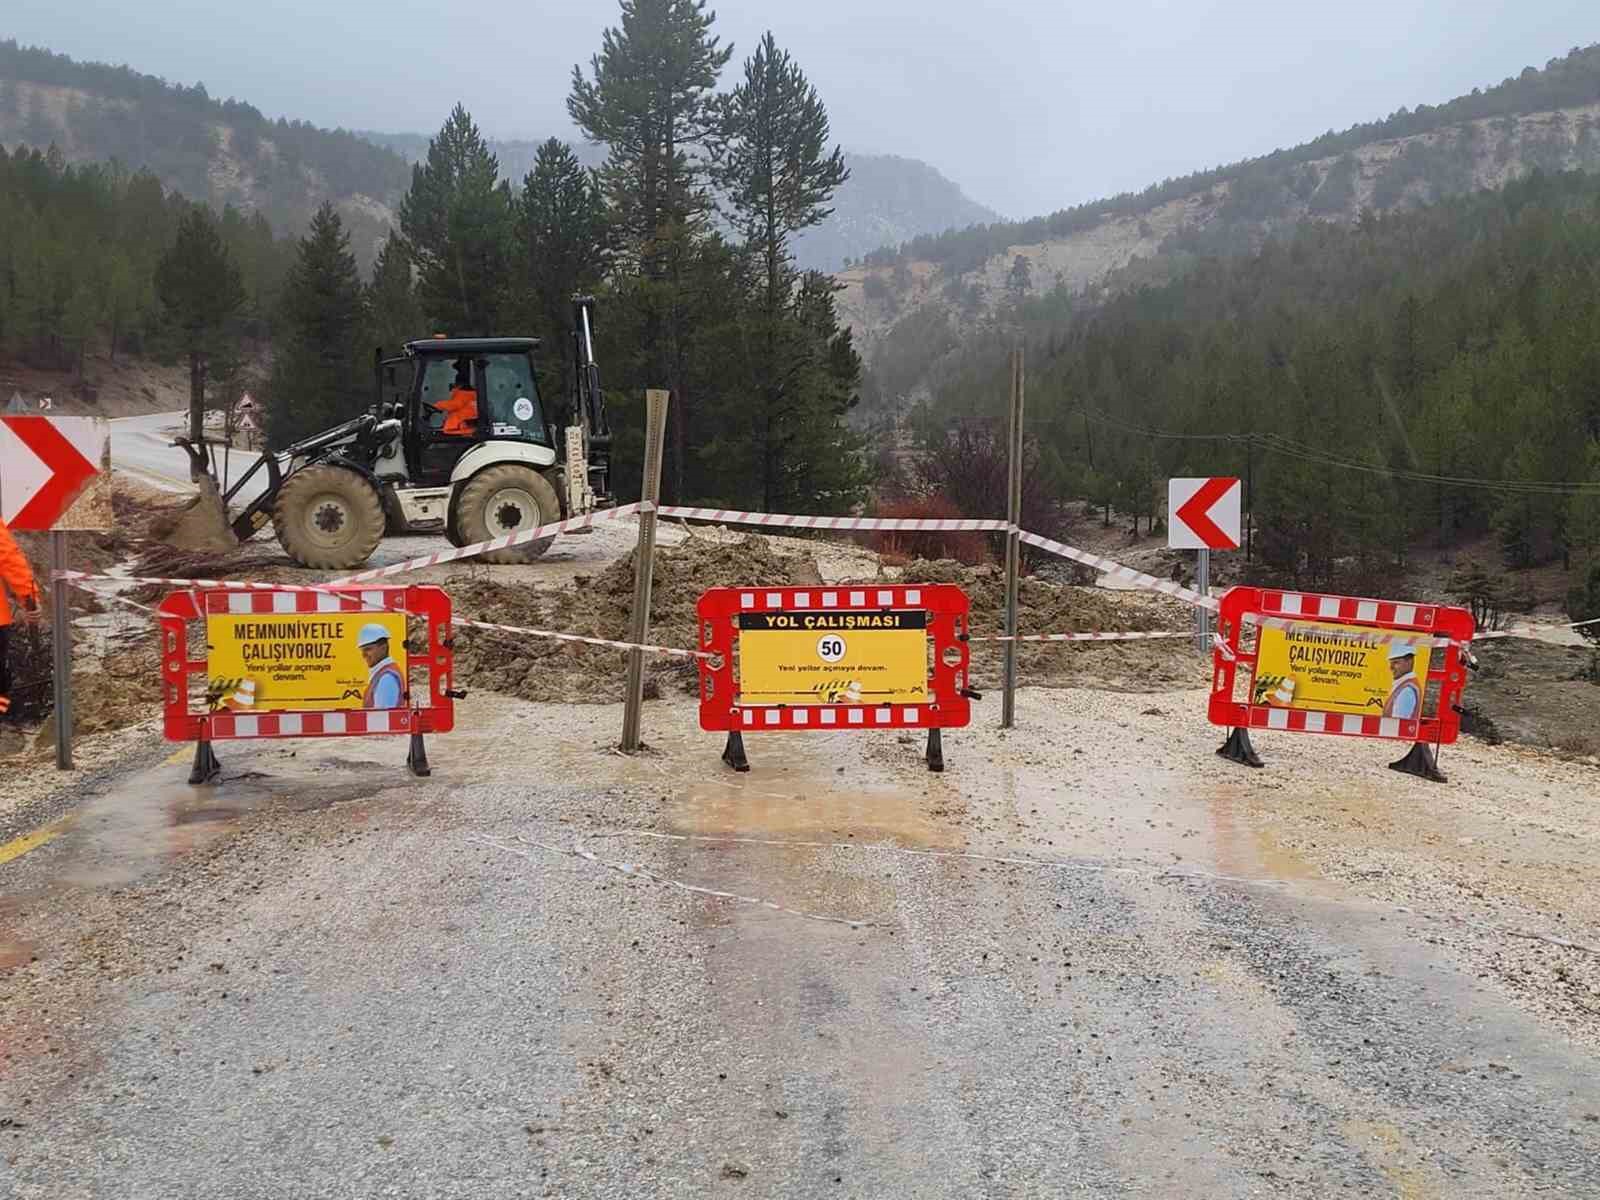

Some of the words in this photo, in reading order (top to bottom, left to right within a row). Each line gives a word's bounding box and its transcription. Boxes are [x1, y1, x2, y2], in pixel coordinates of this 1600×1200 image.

[234, 620, 344, 640] MEMNUNİYETLE
[766, 616, 799, 628] YOL
[804, 616, 900, 629] ÇALIŞMASI
[242, 643, 336, 662] ÇALIŞIYORUZ.
[821, 640, 842, 656] 50
[1289, 645, 1368, 667] ÇALIŞIYORUZ.
[246, 663, 266, 672] Yeni
[267, 663, 292, 673] yollar
[294, 664, 332, 673] açmaya
